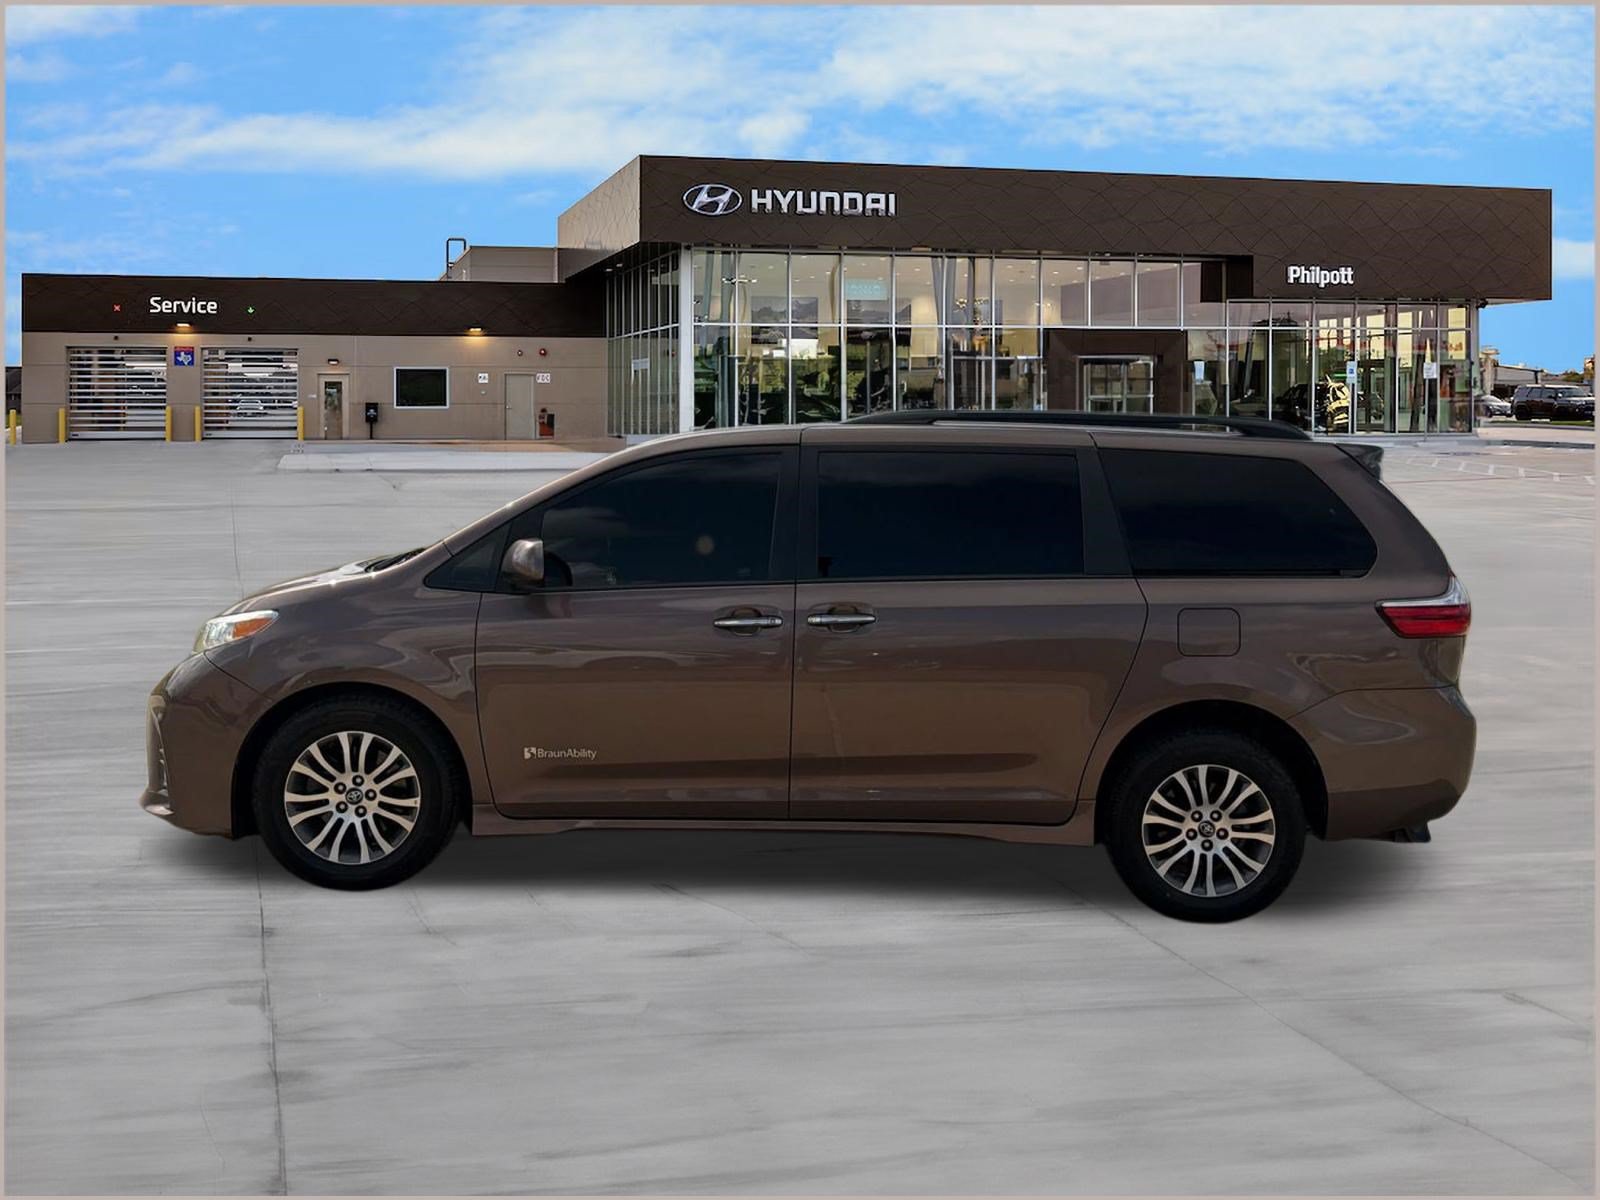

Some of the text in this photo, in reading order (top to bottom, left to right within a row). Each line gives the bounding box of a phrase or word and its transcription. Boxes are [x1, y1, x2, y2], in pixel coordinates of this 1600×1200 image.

[751, 189, 895, 216] HYUNDAI
[1288, 266, 1353, 286] Philpott
[150, 297, 217, 314] Service
[537, 748, 597, 760] BraunAbility
